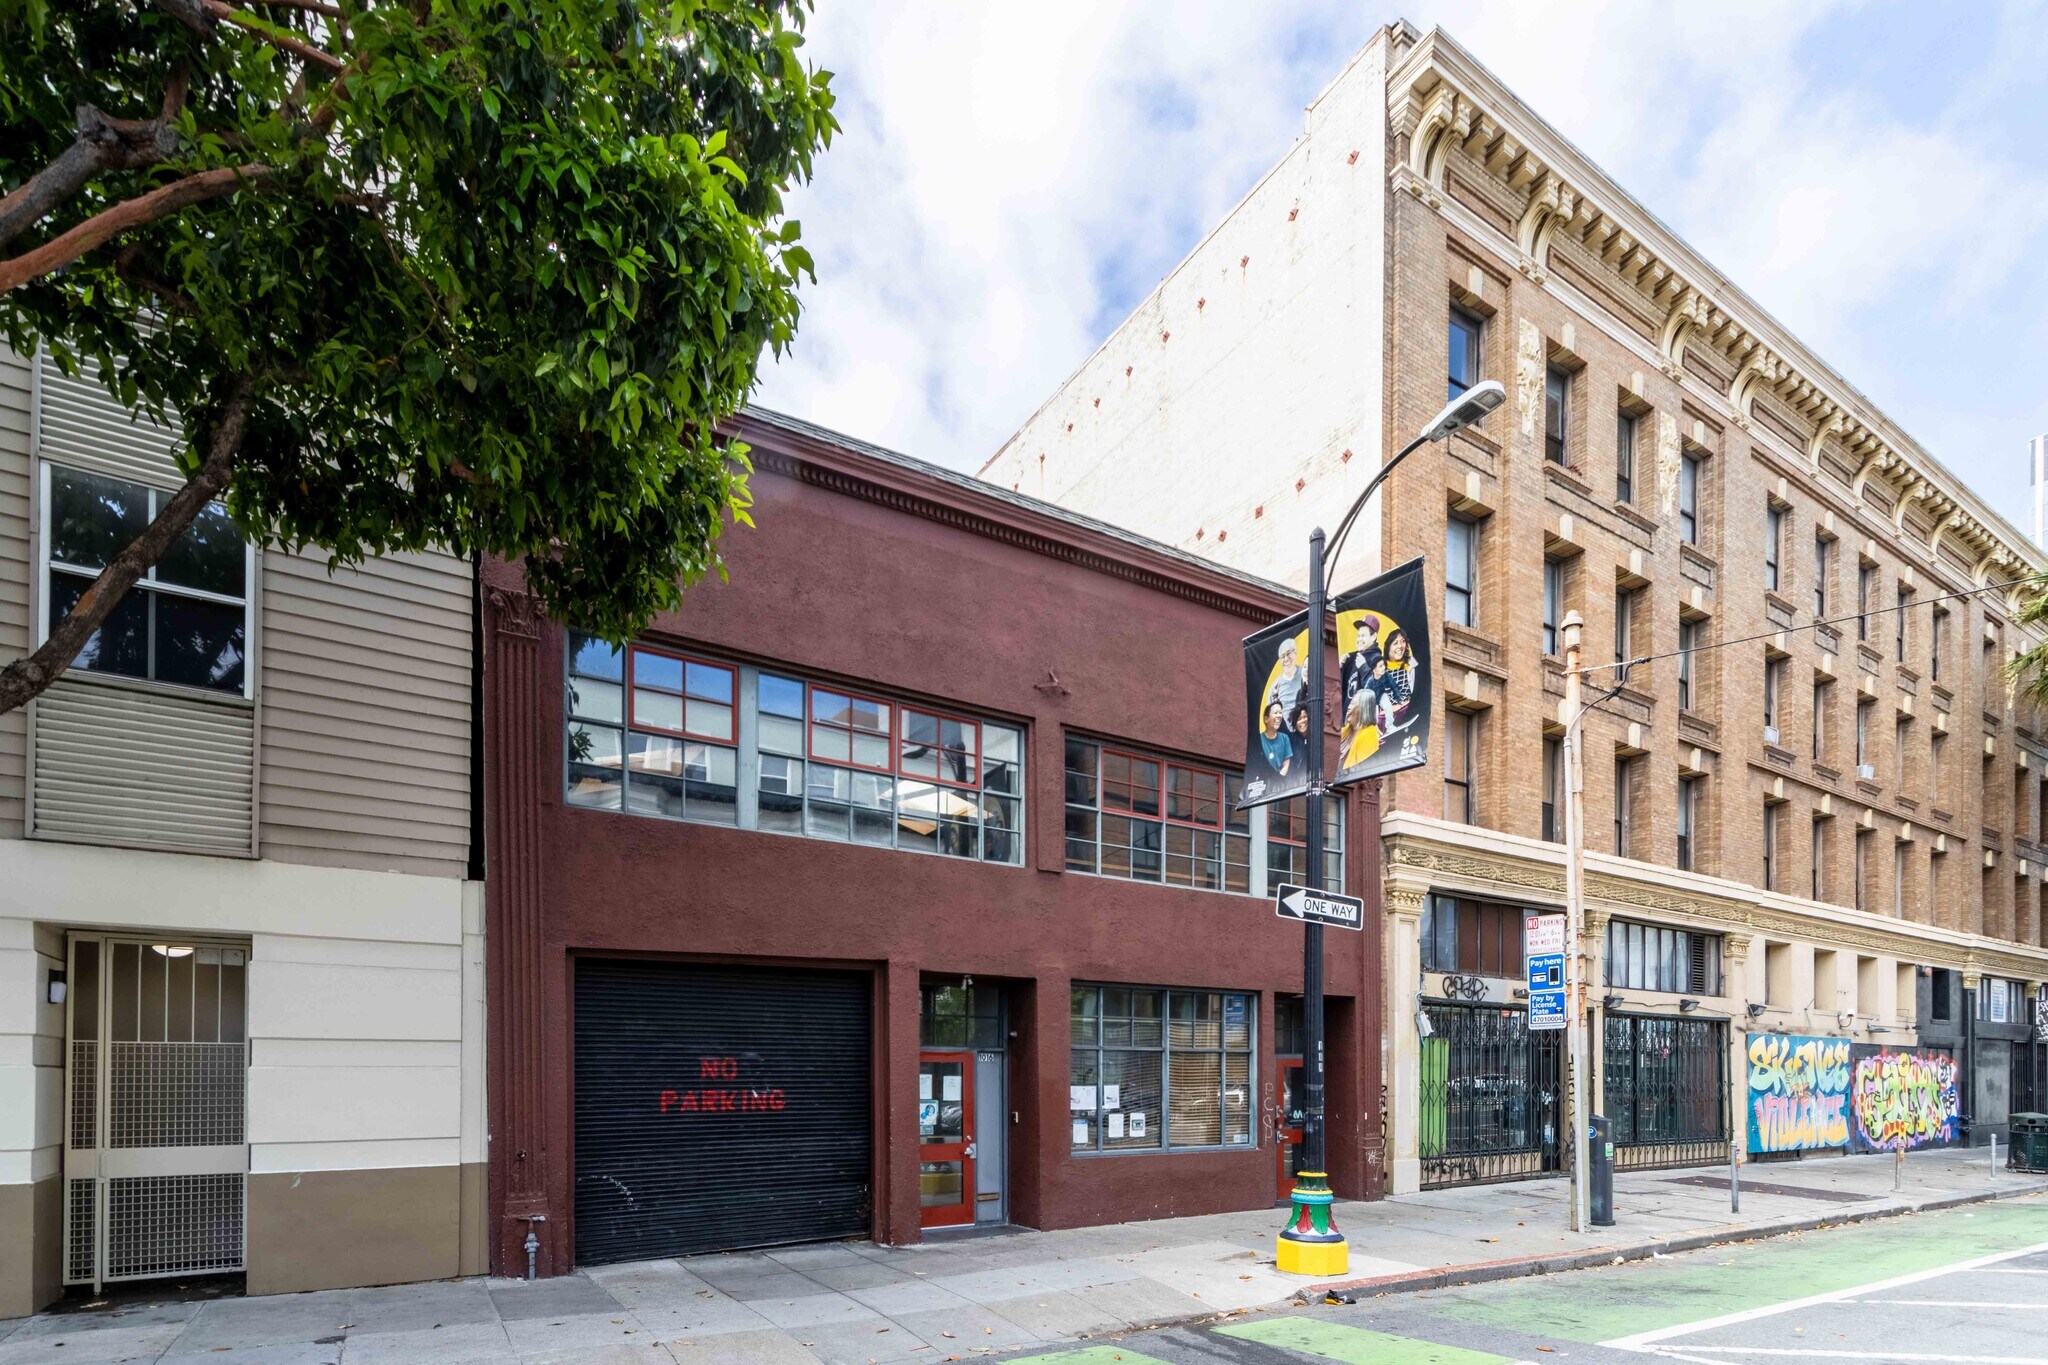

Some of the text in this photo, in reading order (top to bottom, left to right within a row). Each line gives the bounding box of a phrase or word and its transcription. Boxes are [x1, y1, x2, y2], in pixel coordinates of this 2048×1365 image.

[1304, 898, 1354, 919] ONE WAY
[1528, 918, 1563, 930] NO PARKING
[1530, 958, 1562, 968] Pay here
[1532, 995, 1555, 1003] Pay by
[1532, 1001, 1557, 1009] License
[1533, 1015, 1562, 1023] 47010004
[700, 1057, 738, 1081] NO
[660, 1089, 786, 1113] PARKING
